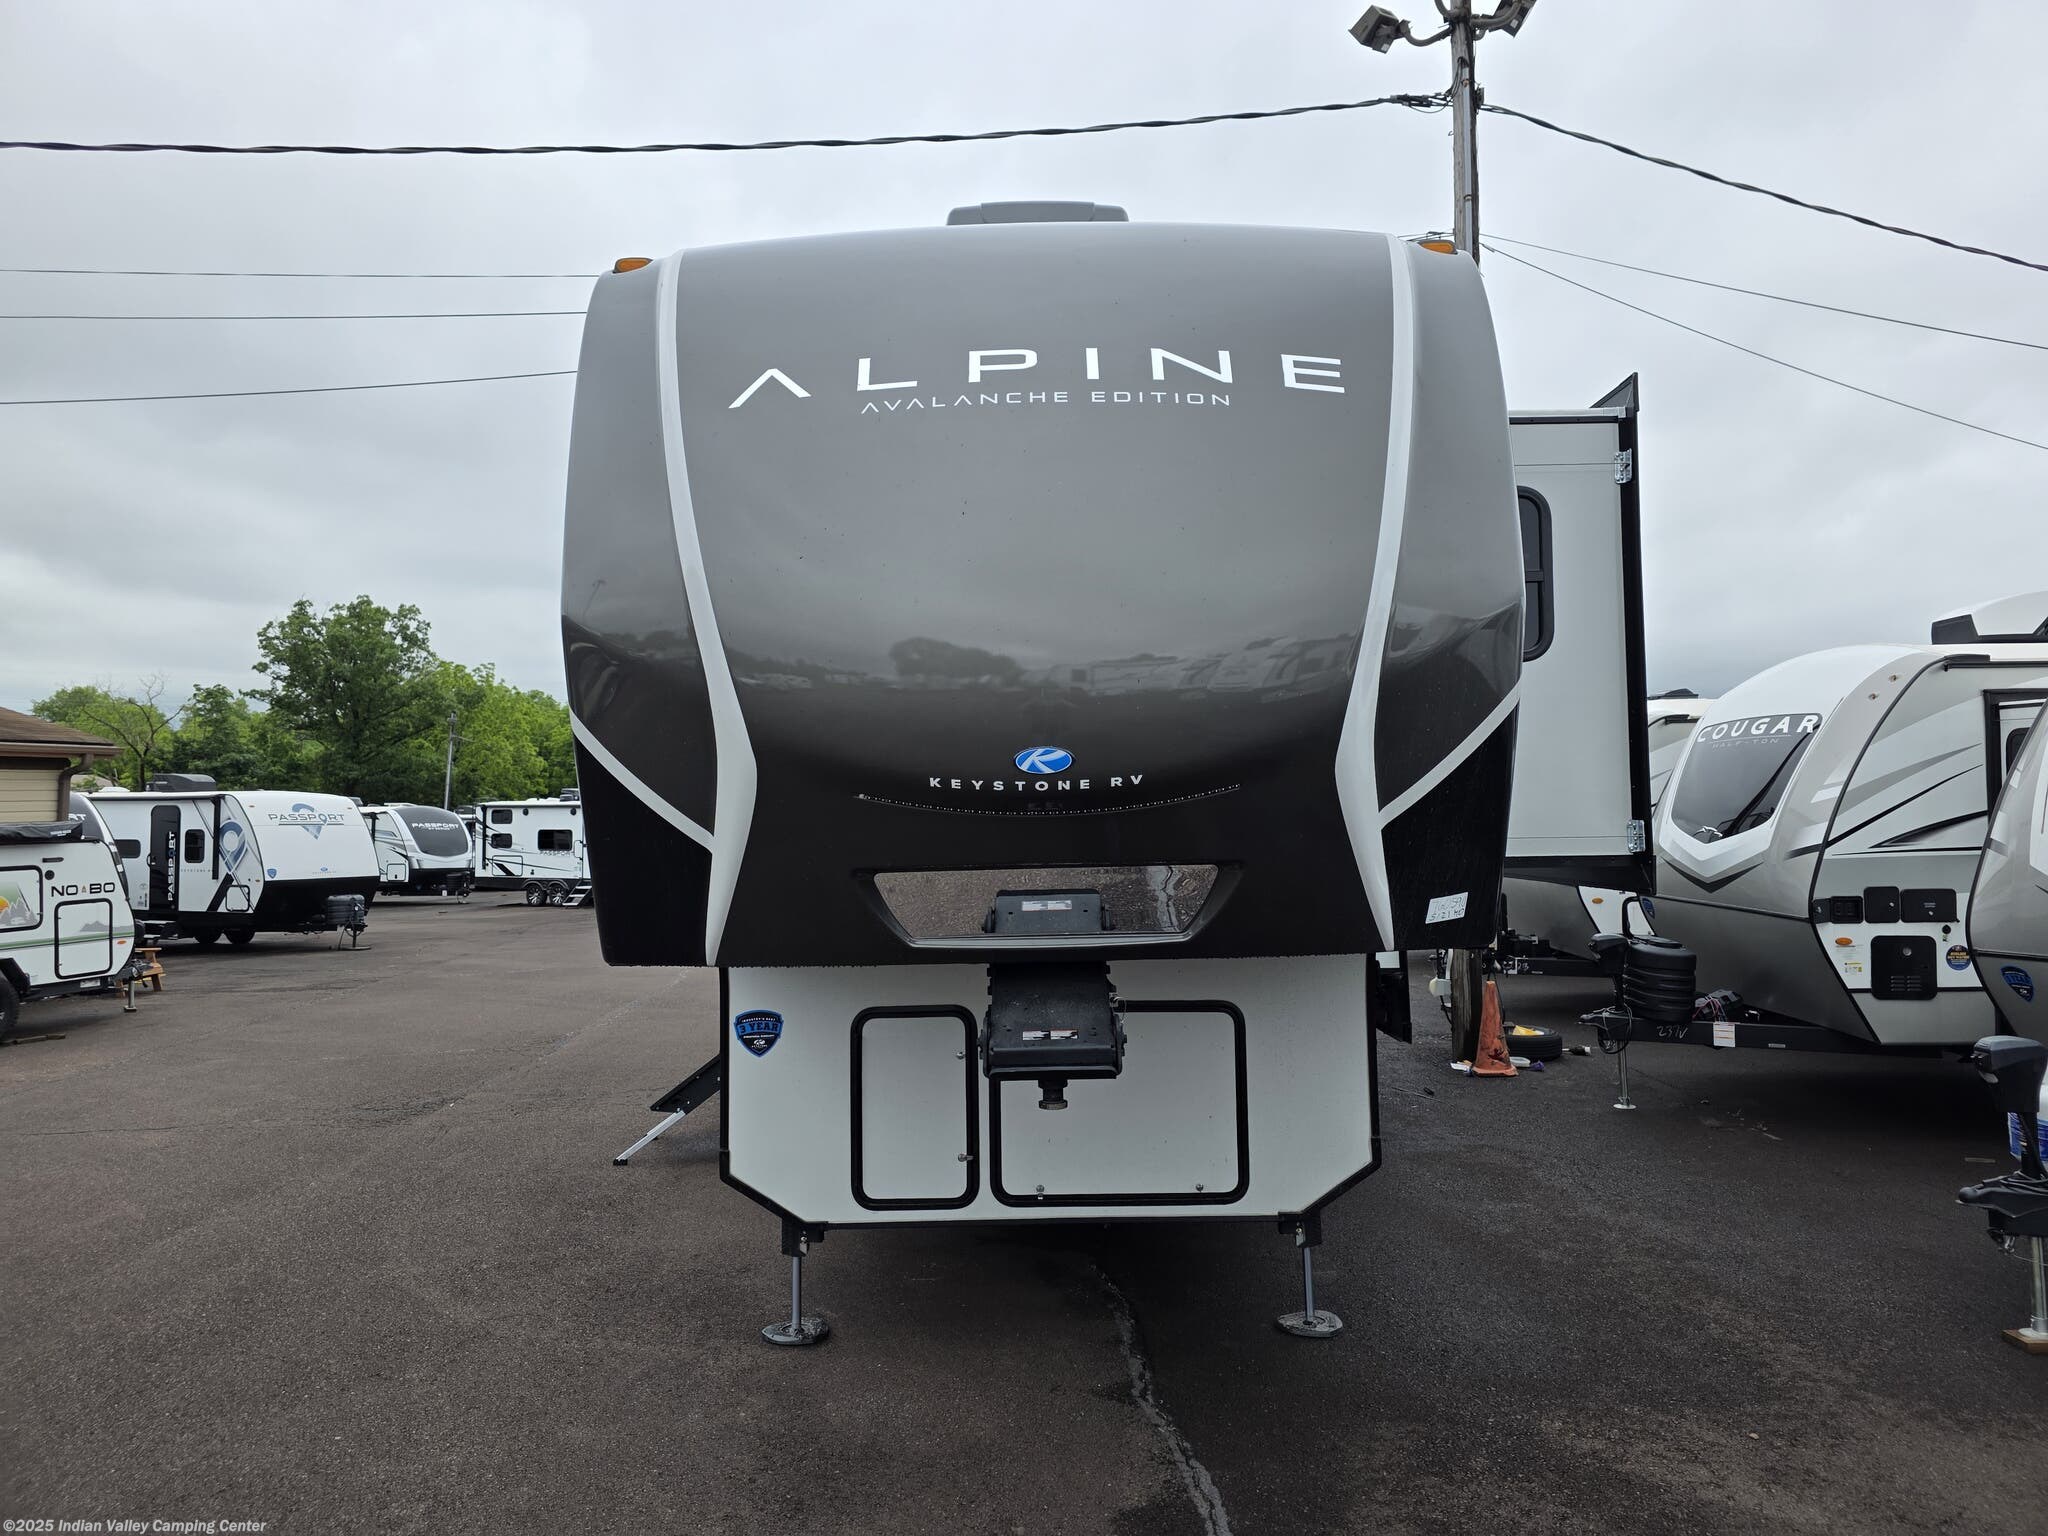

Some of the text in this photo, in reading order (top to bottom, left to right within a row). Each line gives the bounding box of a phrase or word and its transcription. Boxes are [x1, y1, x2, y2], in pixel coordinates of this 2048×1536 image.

[728, 347, 1346, 408] ALPINE
[861, 391, 1230, 414] AVALANCHE EDITION
[1697, 715, 1819, 743] COUGAR
[929, 774, 1143, 791] KEYSTONE RV
[268, 813, 344, 824] PASSPORT
[168, 831, 176, 901] PASSPORT
[51, 882, 115, 897] NO BO
[739, 1021, 779, 1033] 3 YEAR
